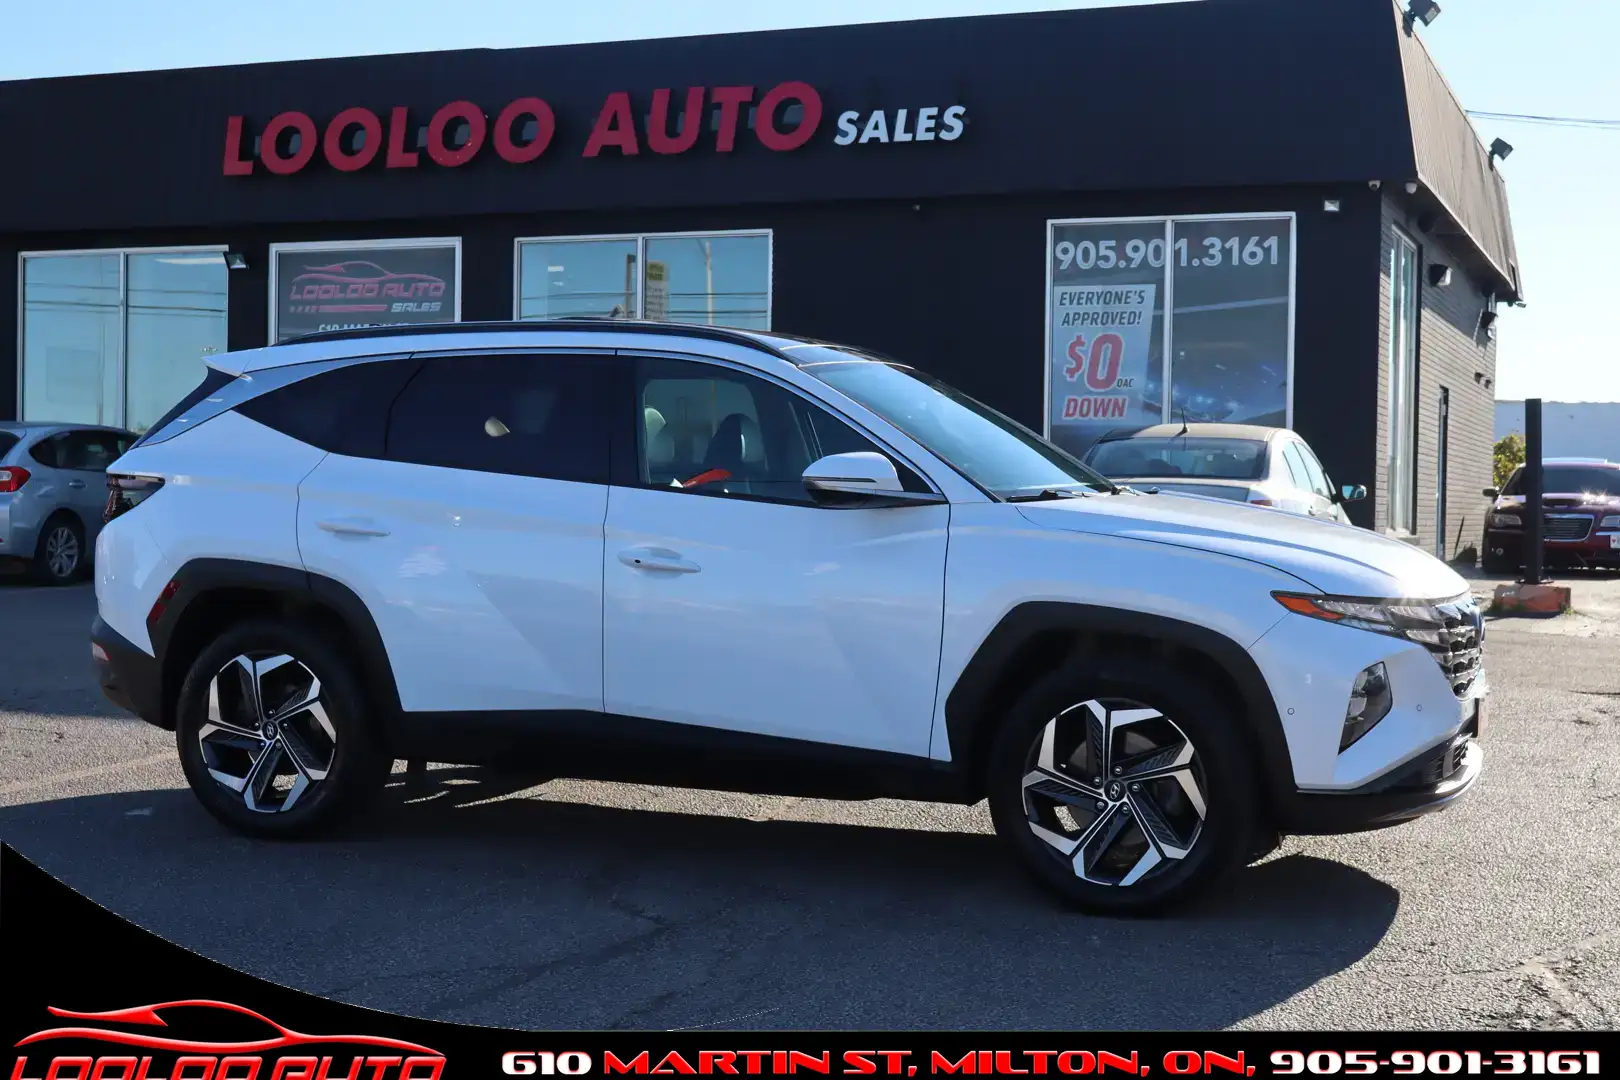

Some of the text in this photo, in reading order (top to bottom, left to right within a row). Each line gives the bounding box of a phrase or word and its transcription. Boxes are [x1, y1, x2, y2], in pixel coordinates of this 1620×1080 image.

[223, 81, 967, 176] LOOLOO AUTO SALES
[1055, 236, 1279, 270] 905.901.3161
[289, 281, 446, 300] LOOLOO AUTO
[1059, 289, 1146, 306] EVERYONE'S
[390, 302, 442, 313] SALES
[1061, 310, 1143, 327] APPROVED!
[1065, 333, 1133, 390] $0 OAC
[1063, 397, 1127, 419] DOWN
